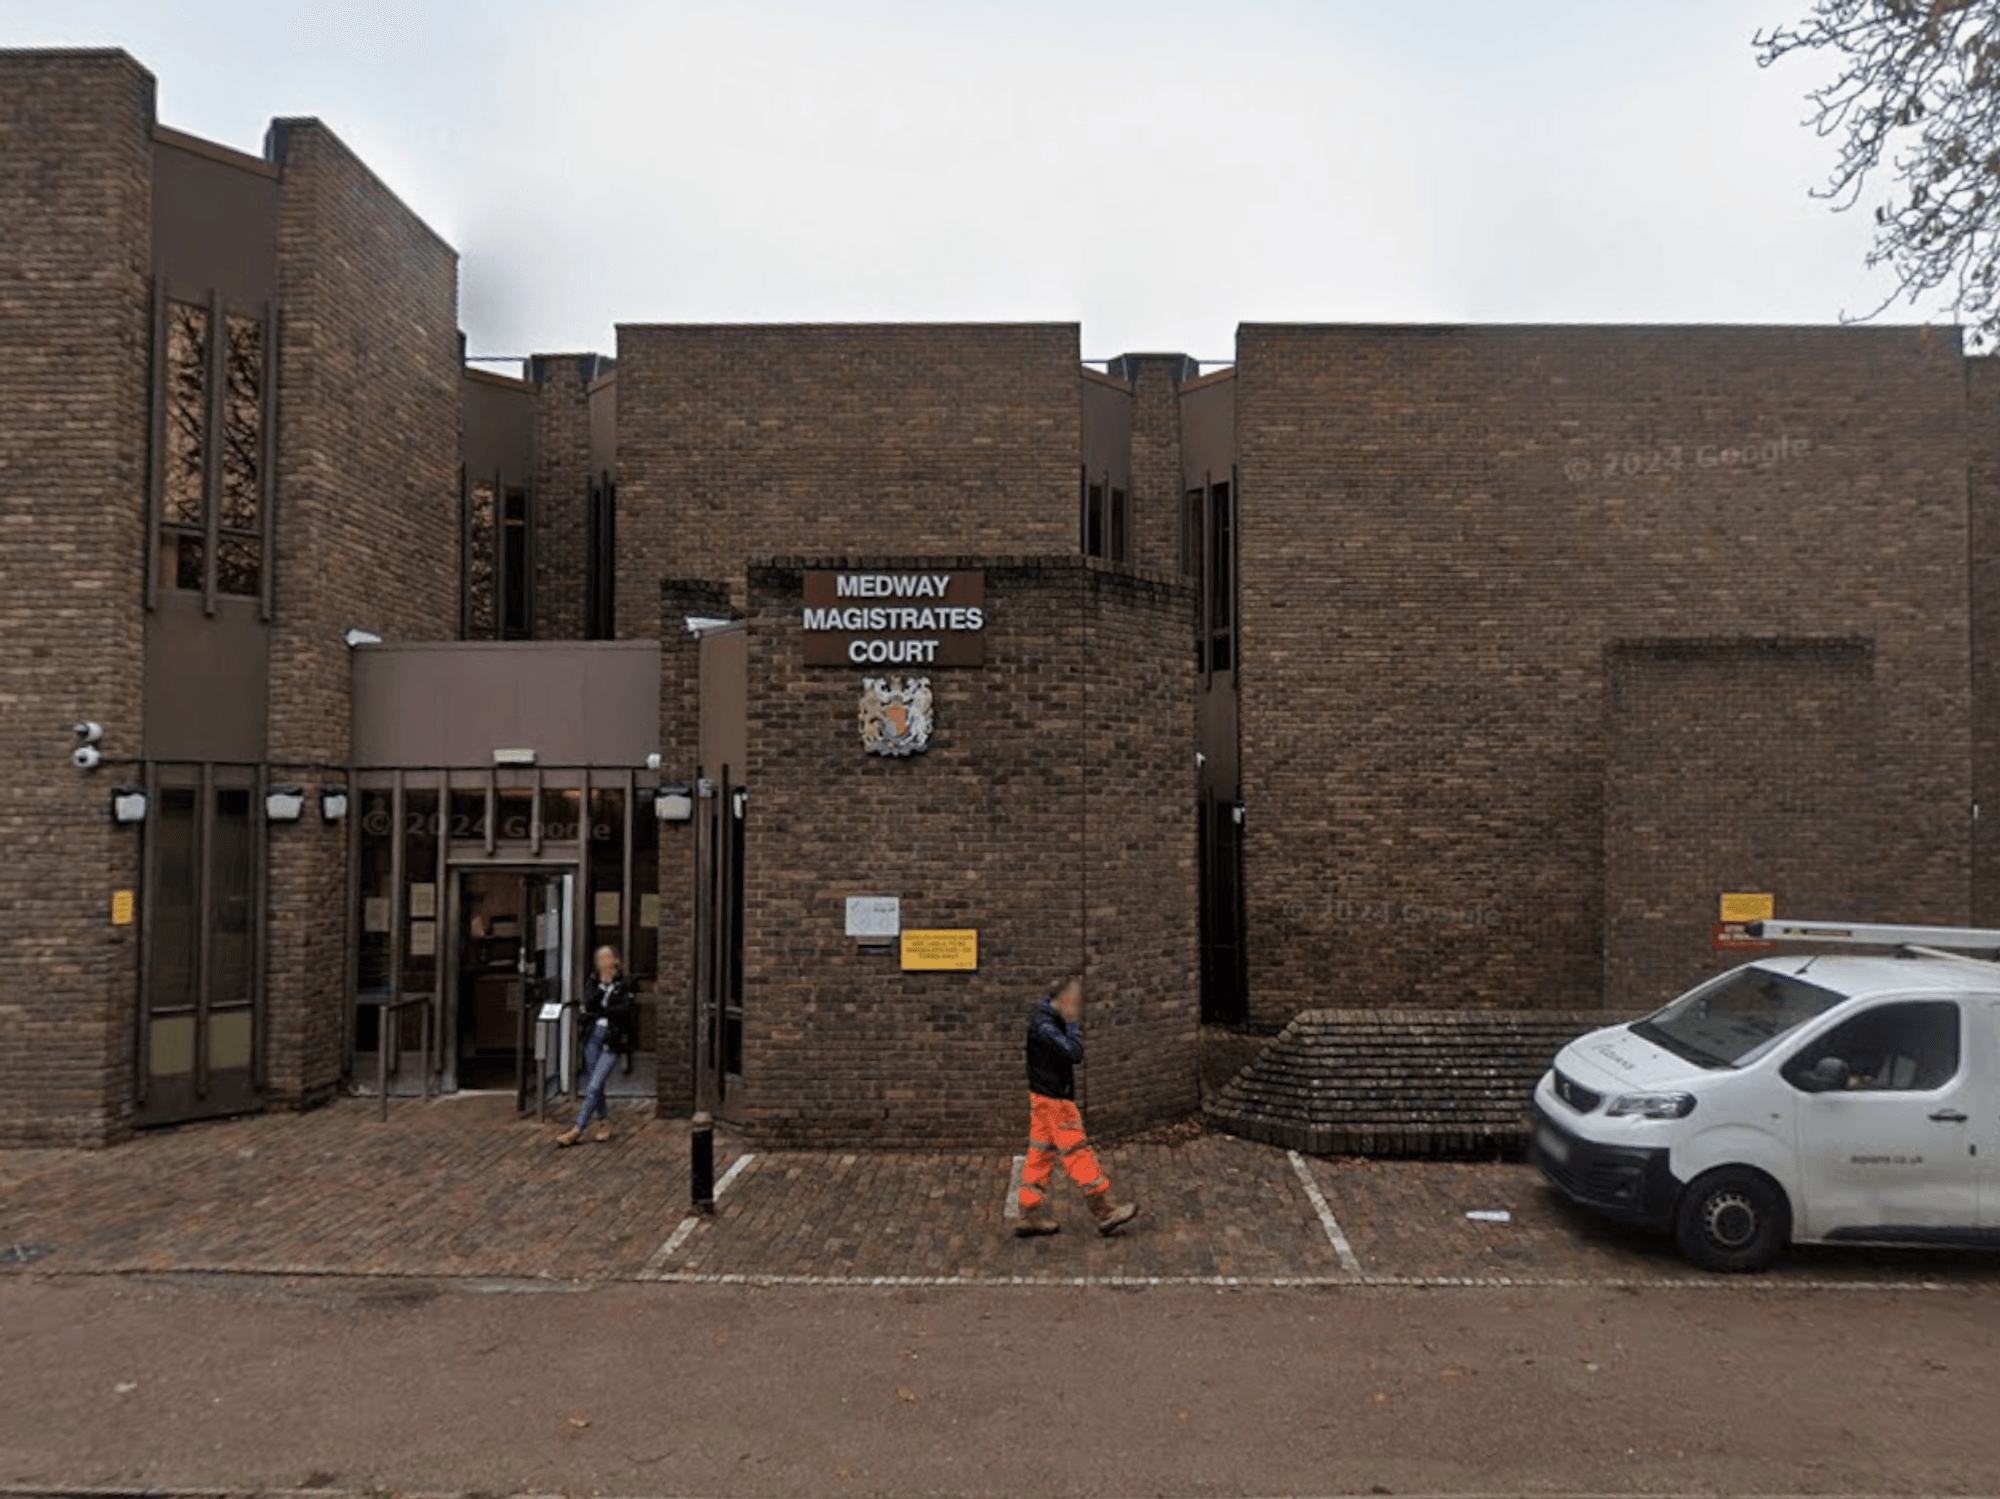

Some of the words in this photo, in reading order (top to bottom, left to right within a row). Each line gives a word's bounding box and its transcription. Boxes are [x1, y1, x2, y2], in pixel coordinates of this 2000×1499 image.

[836, 574, 949, 598] MEDWAY
[803, 607, 984, 631] MAGISTRATES
[848, 640, 939, 663] COURT
